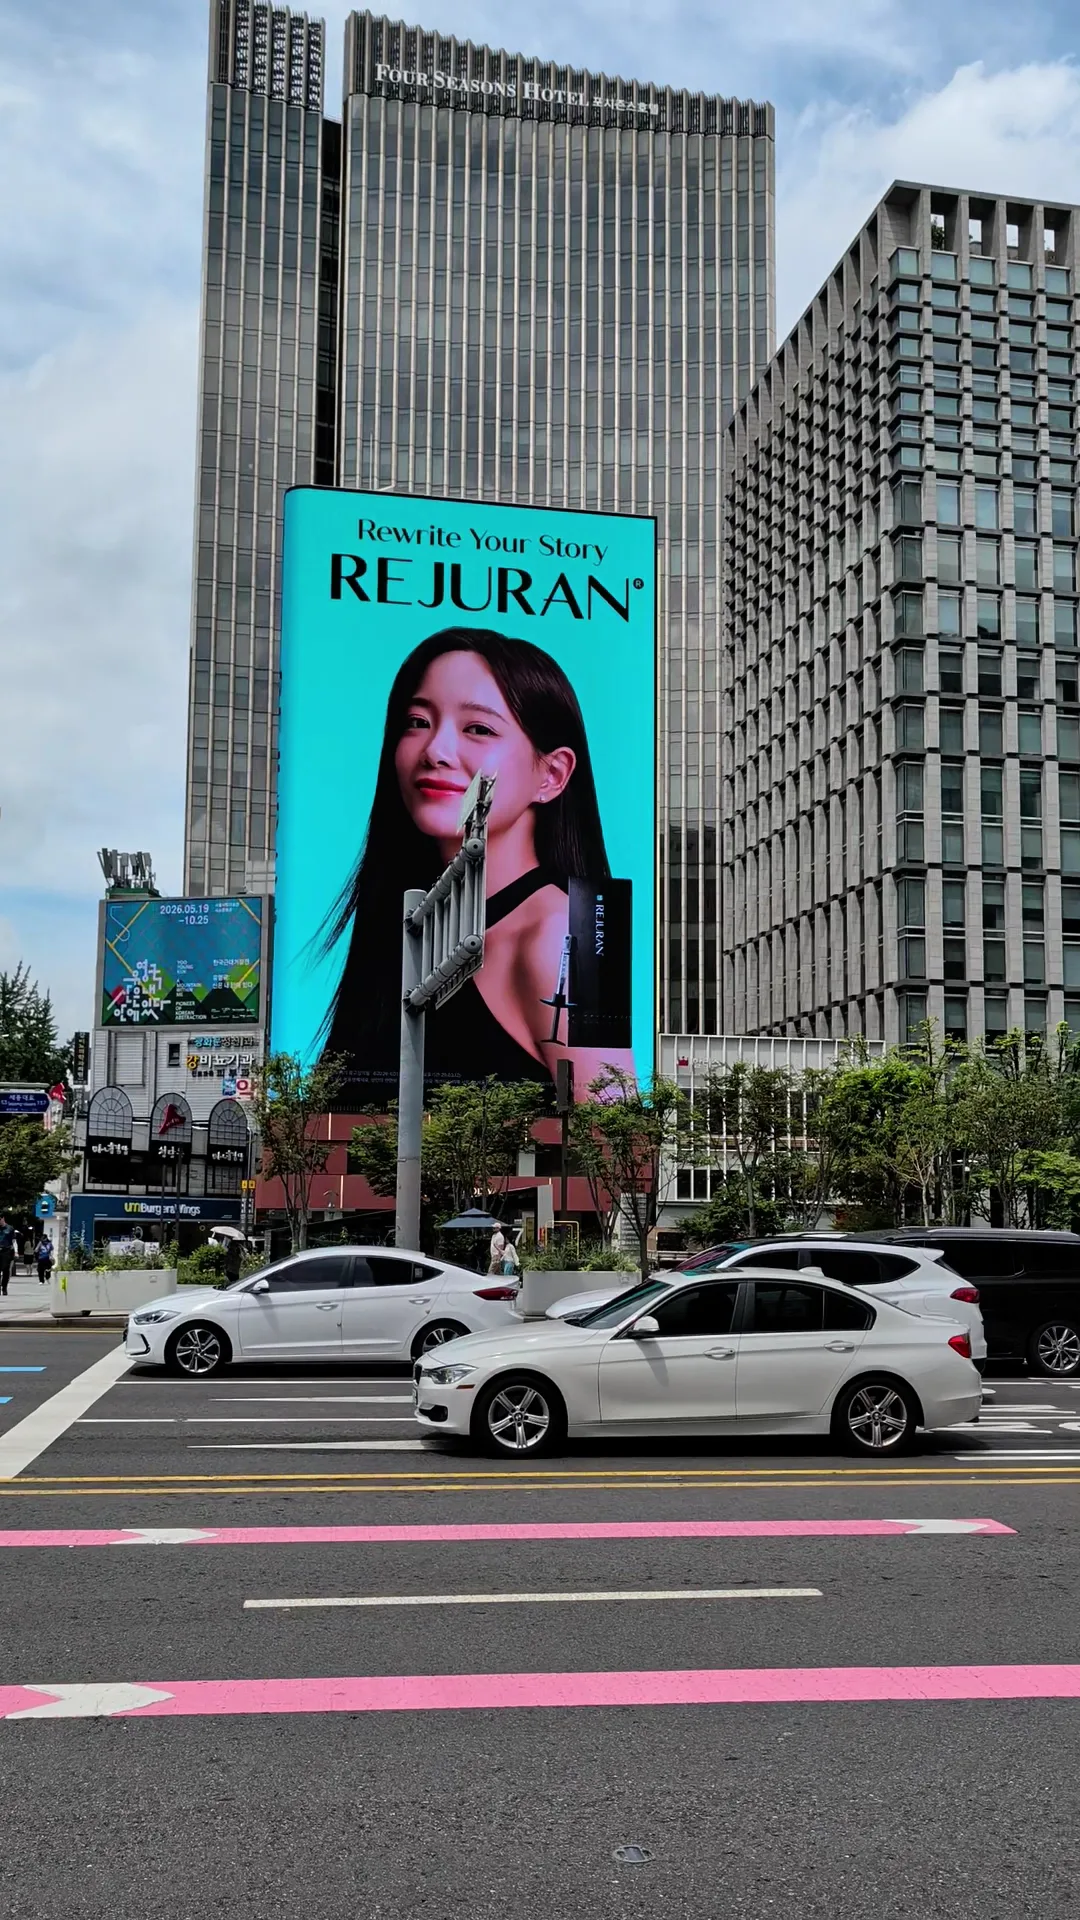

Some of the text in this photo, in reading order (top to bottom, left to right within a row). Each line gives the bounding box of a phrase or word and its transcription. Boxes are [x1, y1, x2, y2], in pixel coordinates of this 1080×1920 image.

[375, 63, 590, 107] FOUR SEASONS HOTEL
[358, 518, 609, 567] Rewrite Your Story
[160, 903, 210, 915] 2026.05.19
[595, 904, 605, 956] REJURAN
[186, 1053, 255, 1070] 강비뇨기과
